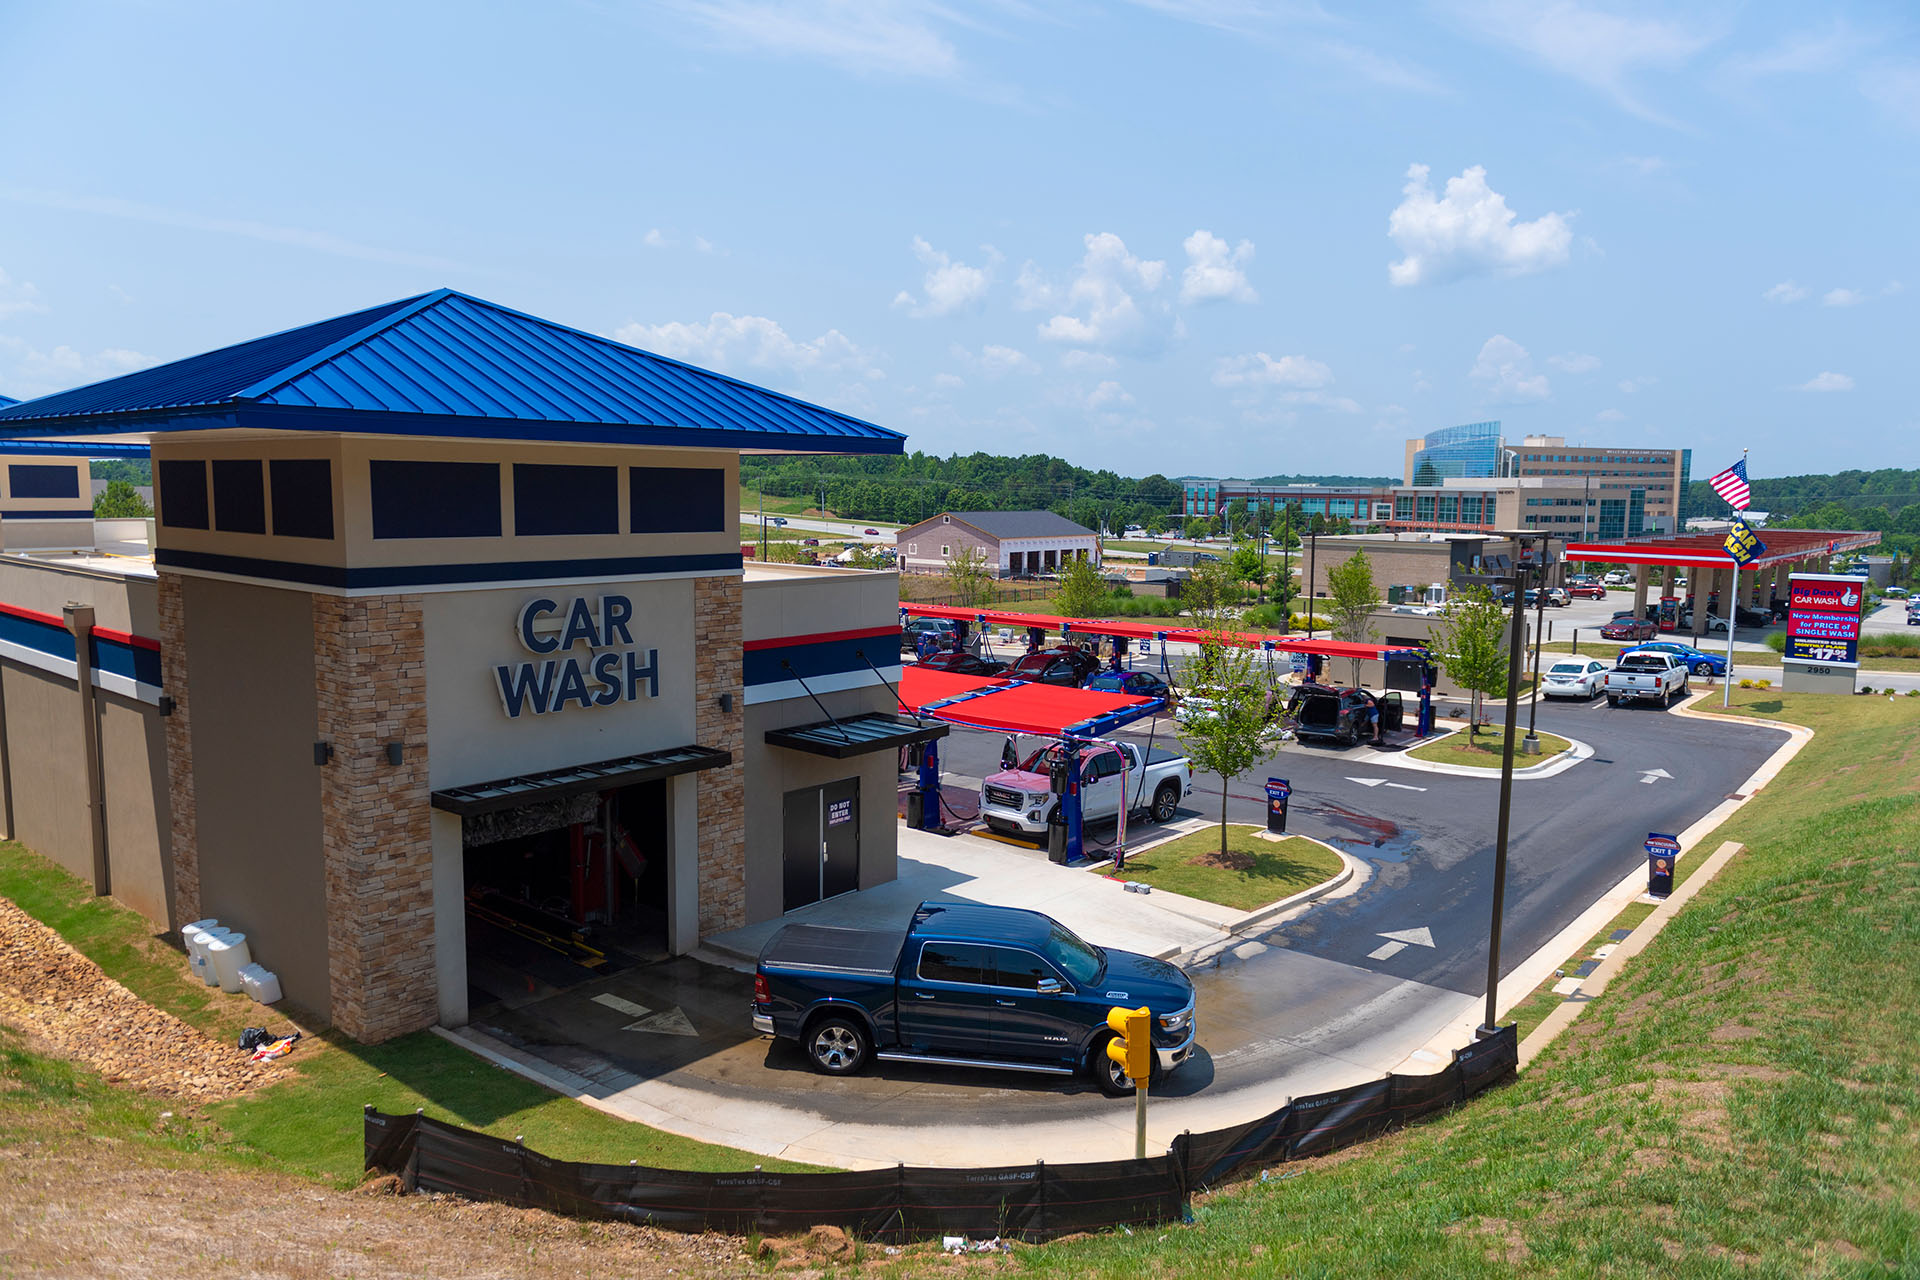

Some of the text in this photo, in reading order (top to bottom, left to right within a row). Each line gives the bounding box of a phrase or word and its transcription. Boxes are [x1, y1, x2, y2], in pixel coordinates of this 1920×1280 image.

[1731, 523, 1757, 550] CAR
[1793, 587, 1841, 597] Big Dan's
[1794, 596, 1839, 605] CAR WASH
[517, 594, 635, 654] CAR
[1814, 622, 1840, 630] PRICE
[1796, 628, 1855, 638] SINGLE WASH
[1807, 666, 1831, 674] 2950
[492, 648, 660, 719] WASH
[832, 809, 849, 818] ENTER
